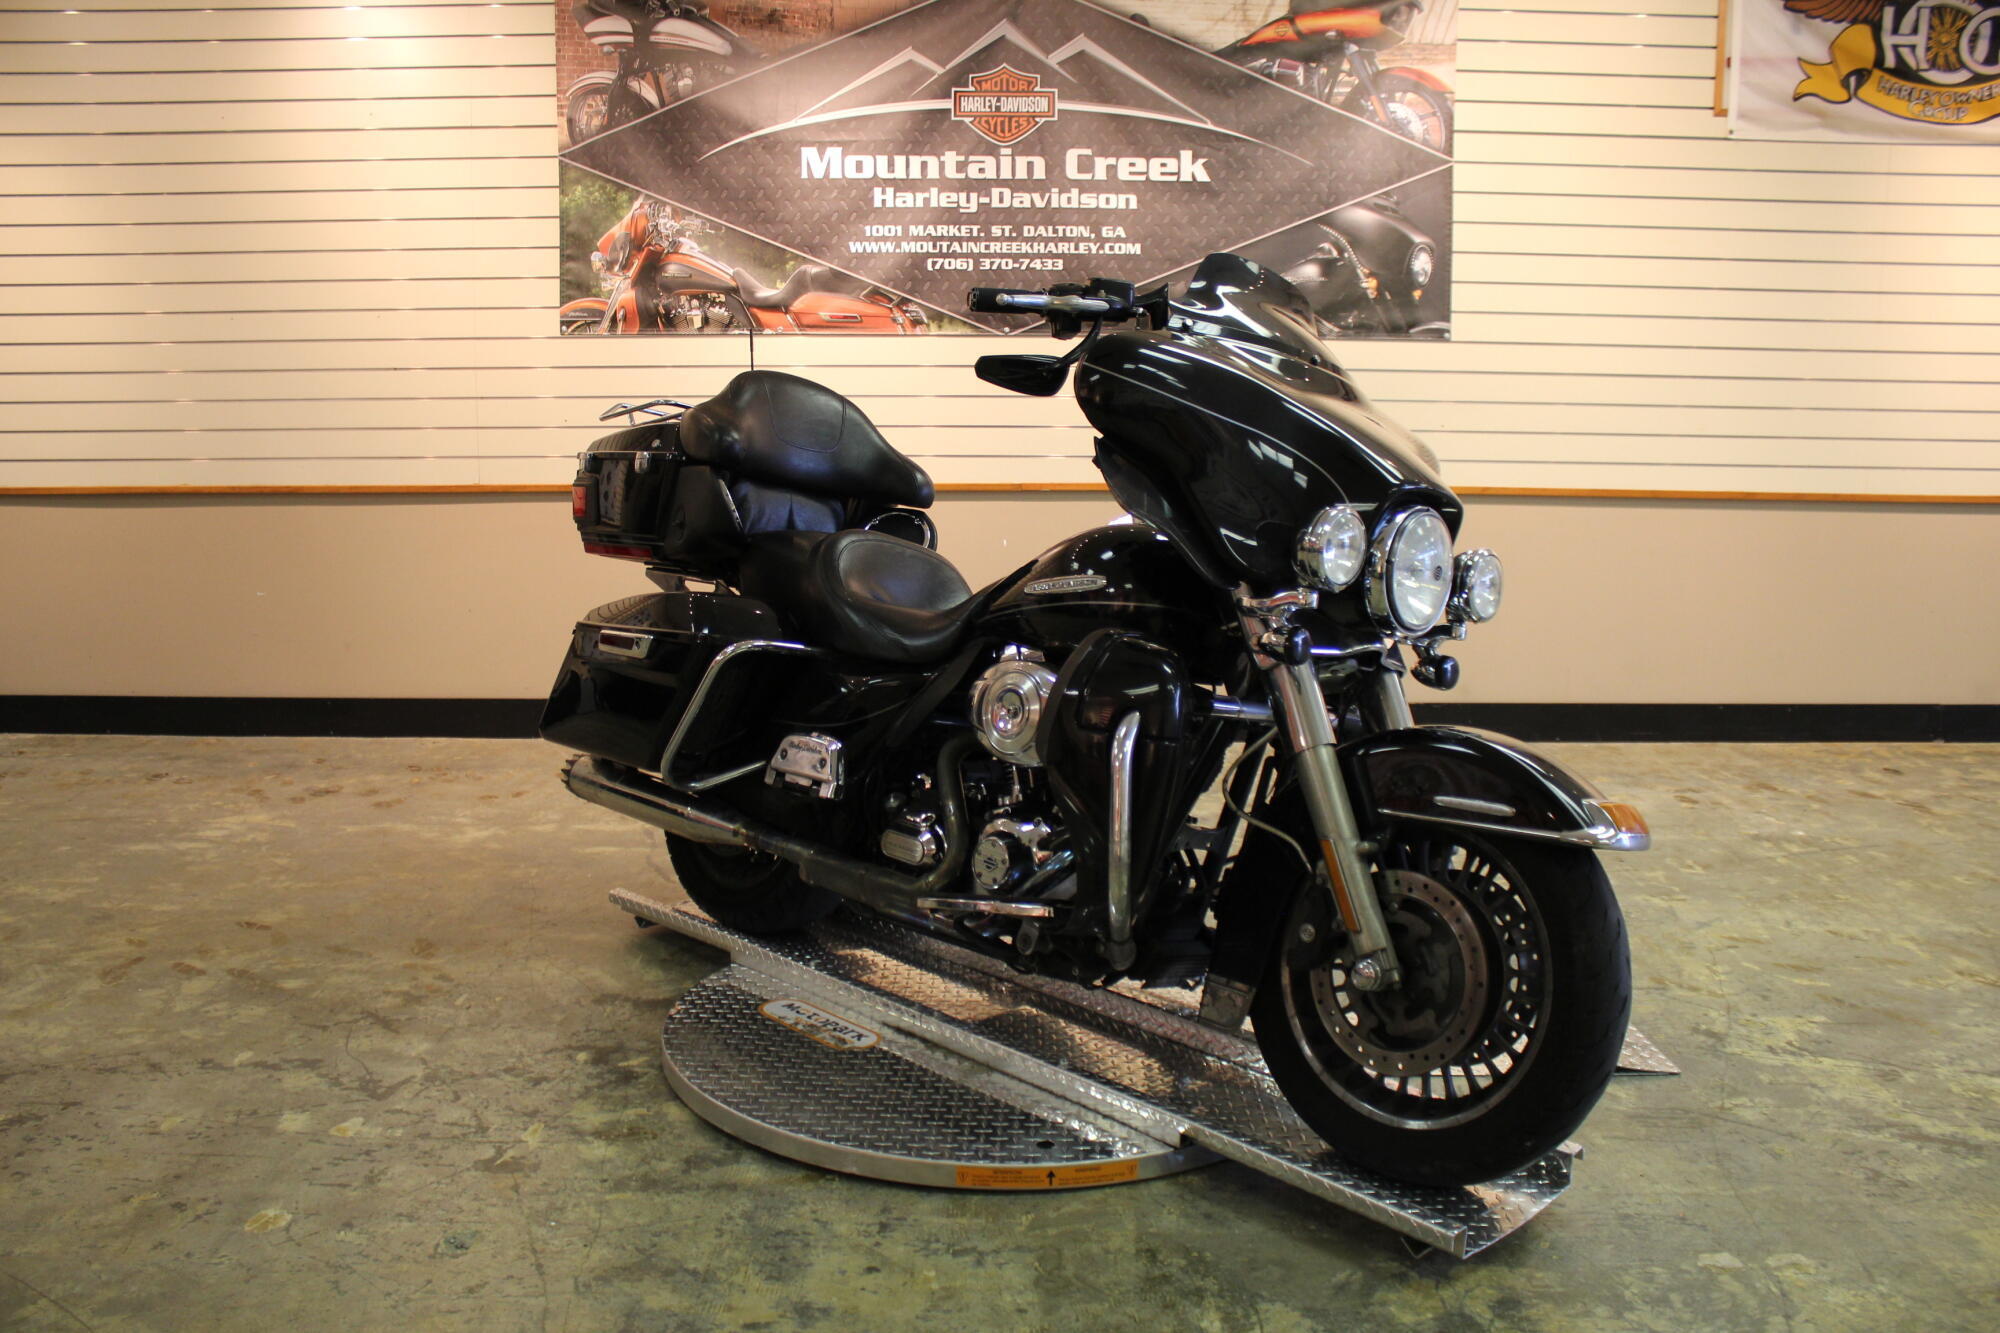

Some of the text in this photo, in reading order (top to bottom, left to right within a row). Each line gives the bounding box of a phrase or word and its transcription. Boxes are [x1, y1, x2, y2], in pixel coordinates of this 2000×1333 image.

[981, 74, 1029, 91] MOTOR
[1876, 75, 1941, 105] HARLEY
[960, 97, 1049, 113] HARLEY-DAVIDSON
[980, 117, 1029, 137] CYCLES
[800, 146, 1212, 182] Mountain Creek
[873, 187, 1138, 213] Harley-Davidson
[864, 224, 1127, 239] 1001 MARKET. ST. DALTON, GA
[848, 241, 1142, 255] WWW.MOUTAINCREEKHARLEY.COM
[927, 258, 1064, 271] (706) 370-7433
